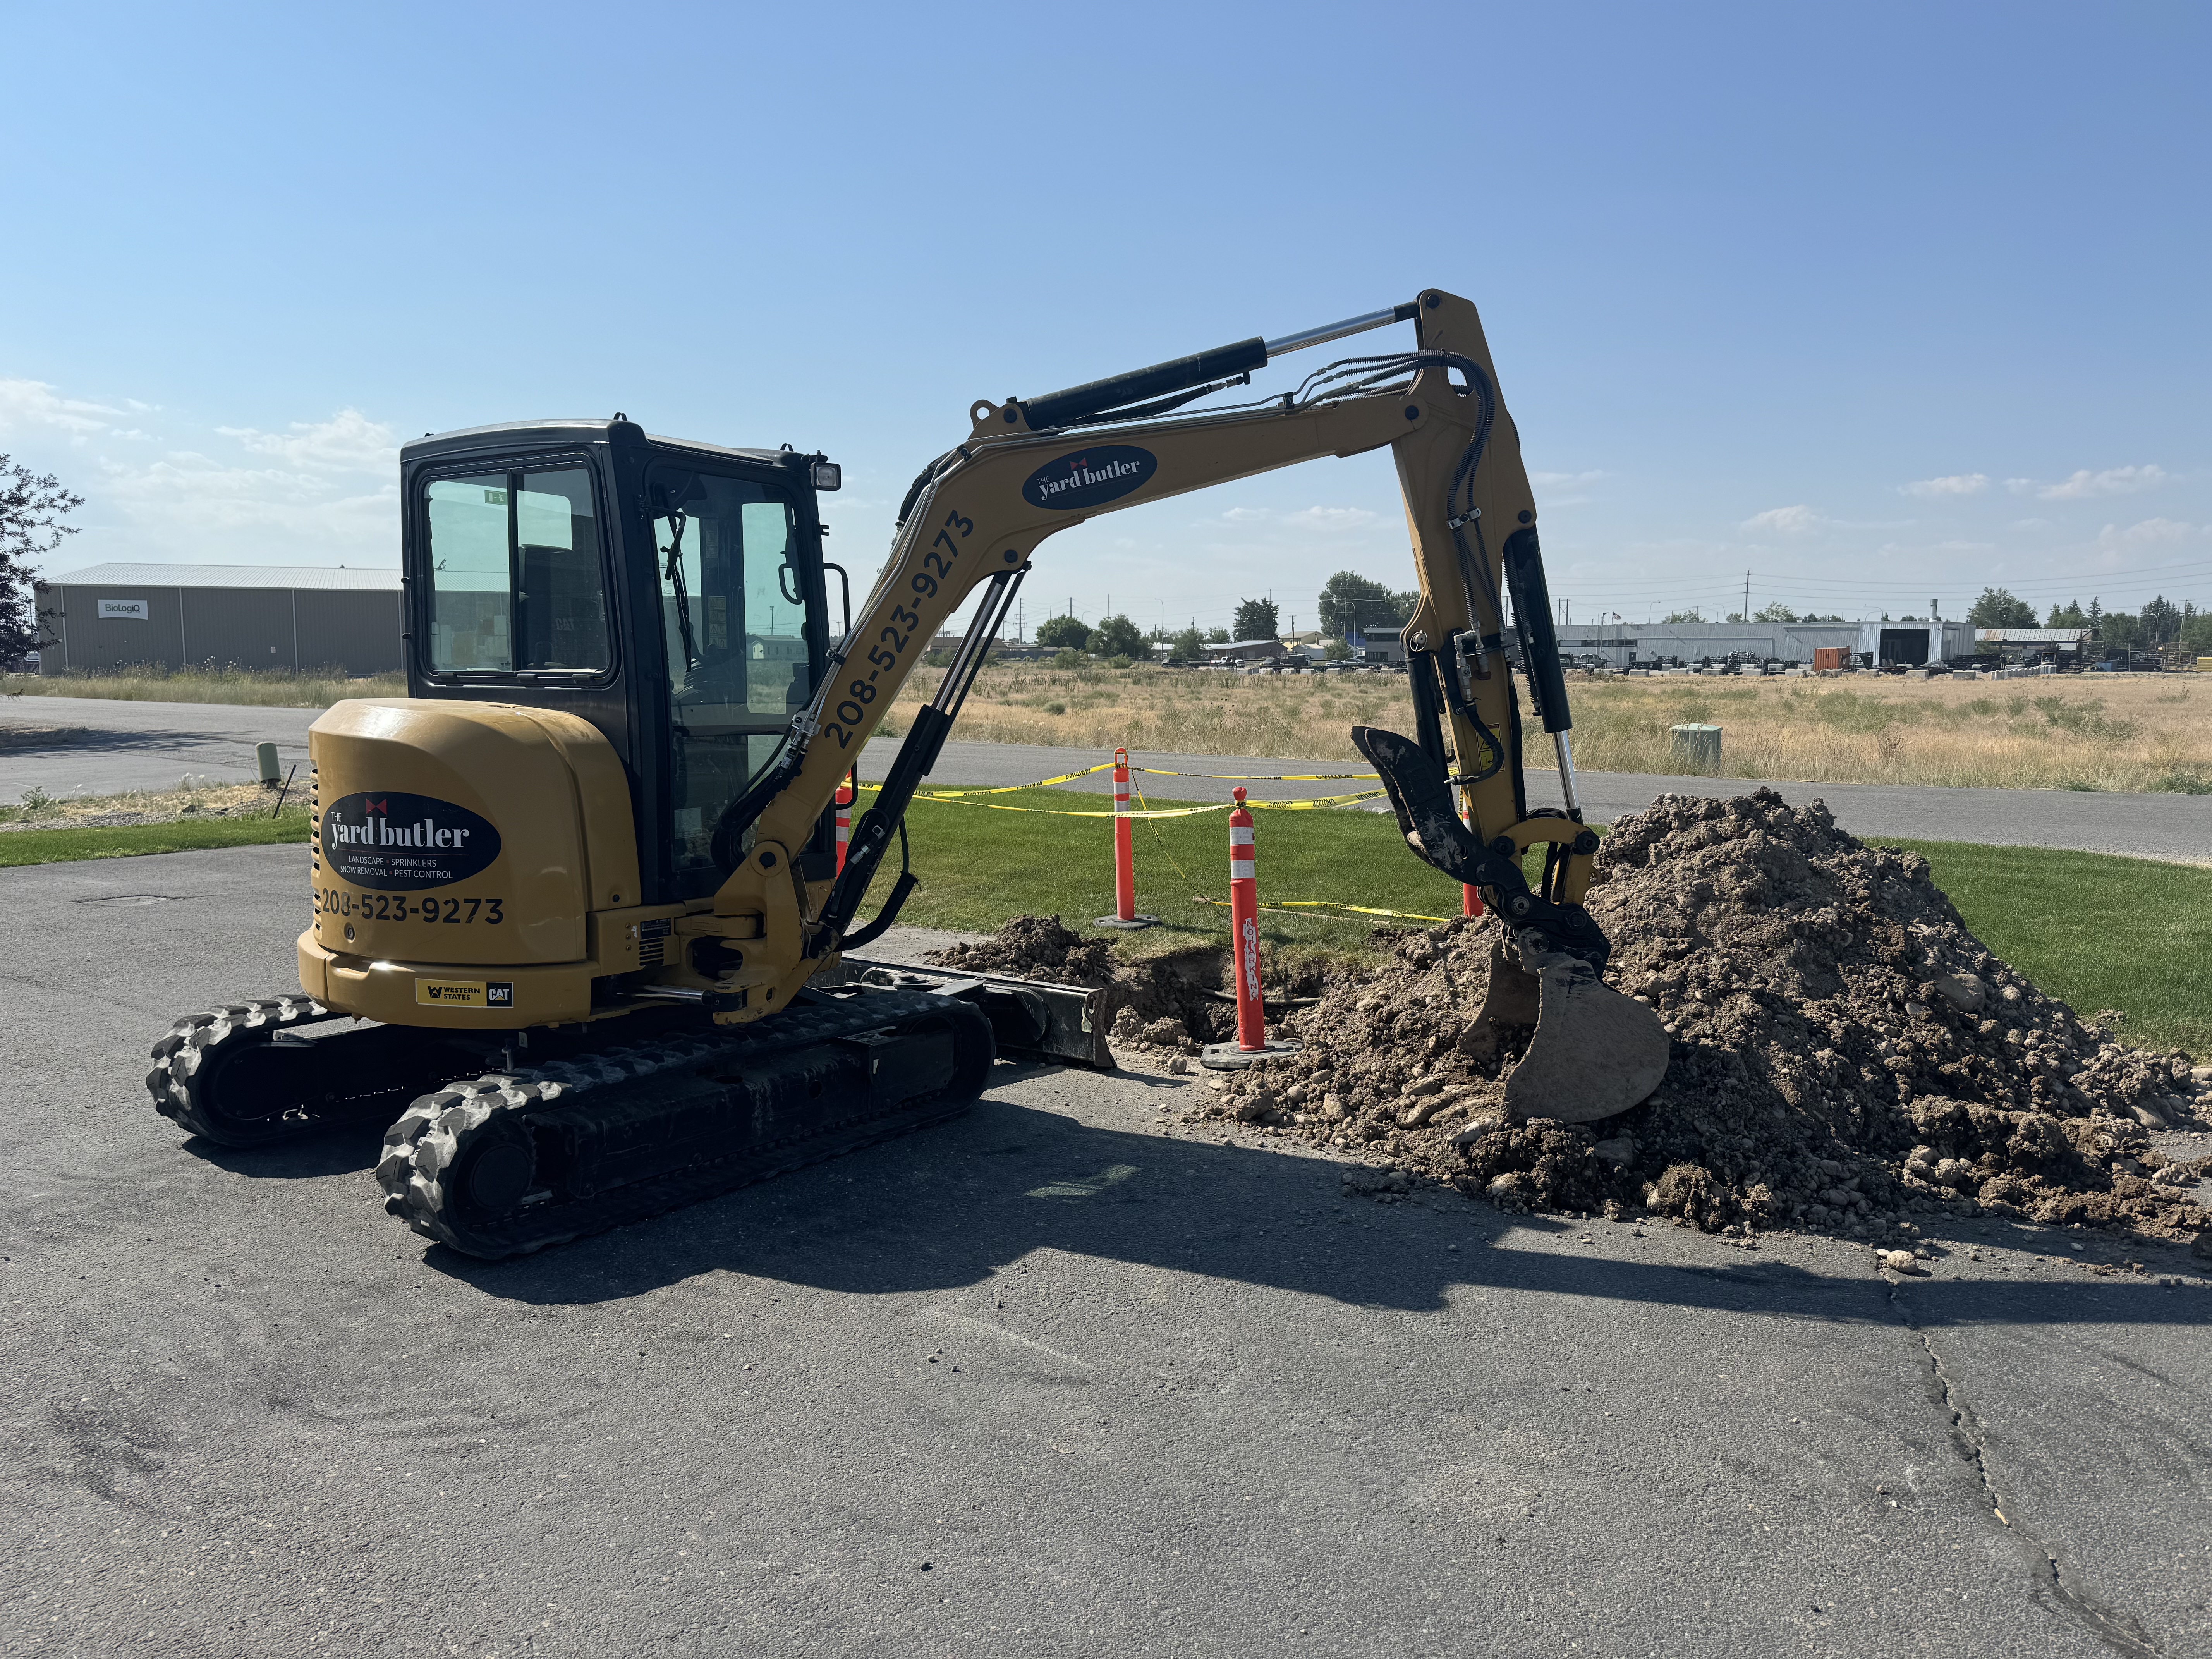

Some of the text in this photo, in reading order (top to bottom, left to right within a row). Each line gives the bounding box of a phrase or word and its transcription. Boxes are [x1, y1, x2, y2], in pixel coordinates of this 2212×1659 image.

[1037, 476, 1050, 484] THE
[1039, 460, 1140, 500] yard butler
[105, 603, 140, 614] BioLogiQ
[824, 509, 974, 749] 208-523-9273
[331, 812, 342, 822] THE
[331, 817, 469, 850] yard butler
[349, 855, 436, 867] LANDSCAPE SPRINKLERS
[340, 865, 453, 879] SNOW REMOVAL PEST CONTROL
[322, 888, 503, 924] 208-523-9273
[489, 988, 510, 1001] CAT
